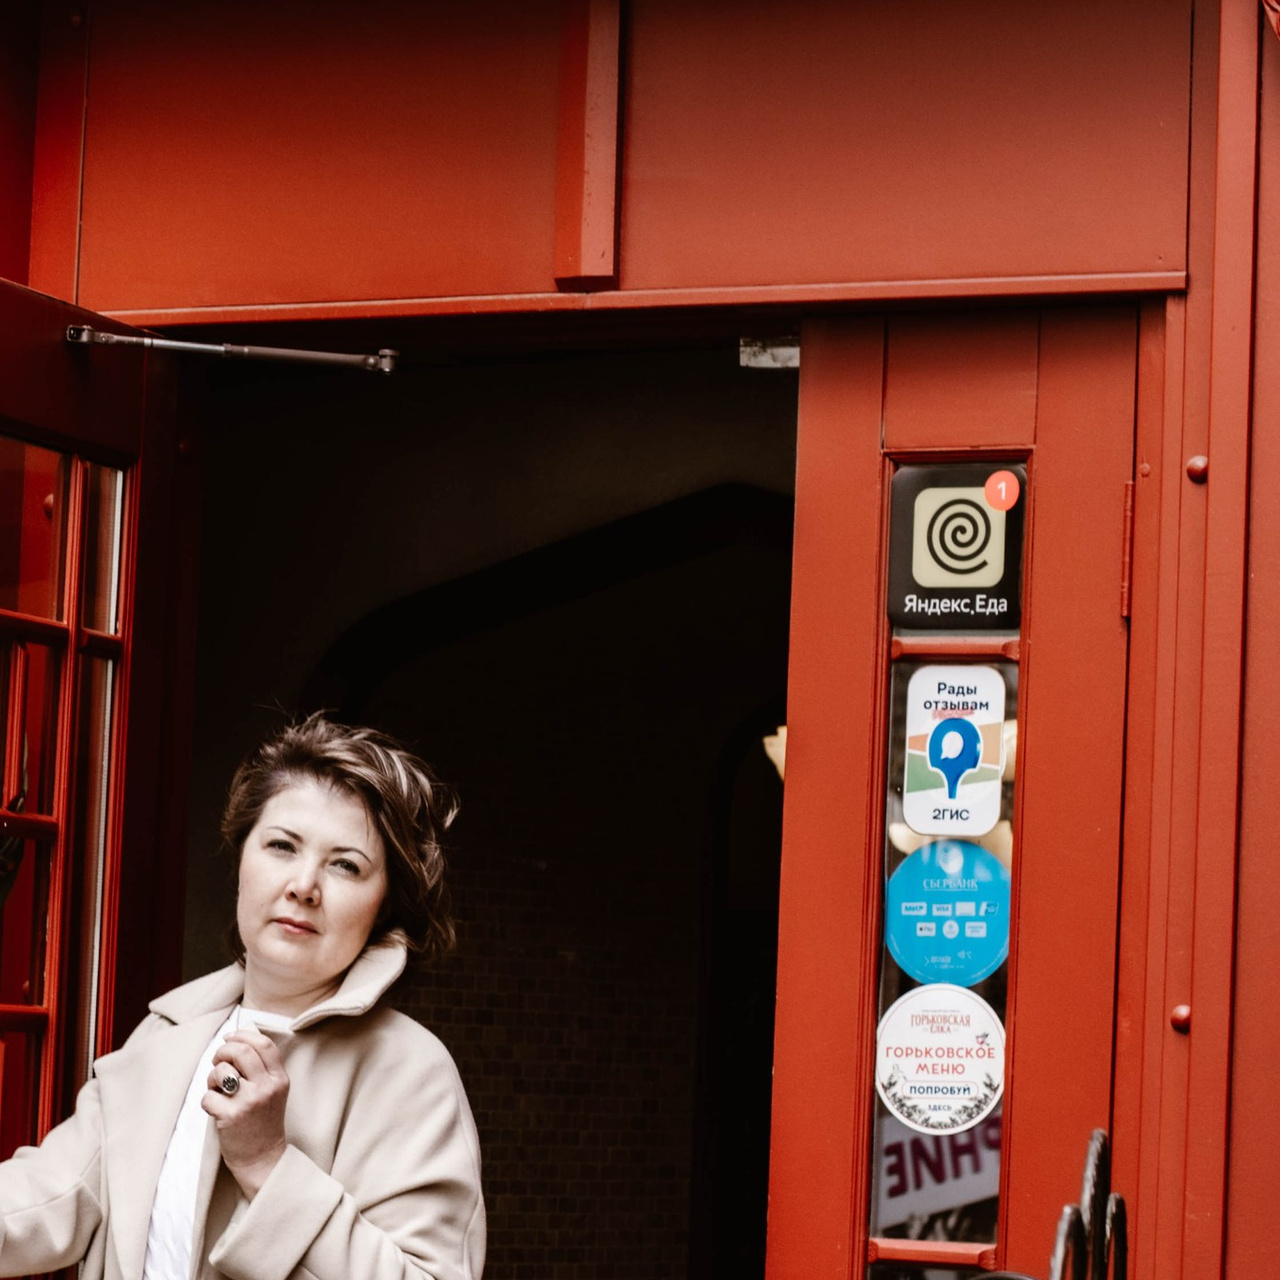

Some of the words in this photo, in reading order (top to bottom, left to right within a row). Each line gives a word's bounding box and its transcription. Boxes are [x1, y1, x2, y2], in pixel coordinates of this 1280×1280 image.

[997, 481, 1006, 501] 1
[904, 594, 1008, 615] Яндекс.Еда
[937, 682, 977, 696] Рады
[923, 700, 989, 711] отзывам
[932, 808, 970, 821] 2ГИС
[923, 878, 978, 890] СБЕРБАНК
[886, 1046, 996, 1059] ГОРЬКОВСКОЕ
[916, 1063, 966, 1075] МЕНЮ
[910, 1084, 971, 1095] ПОПРОБУЙ
[928, 1104, 952, 1112] ЗДЕСЬ
